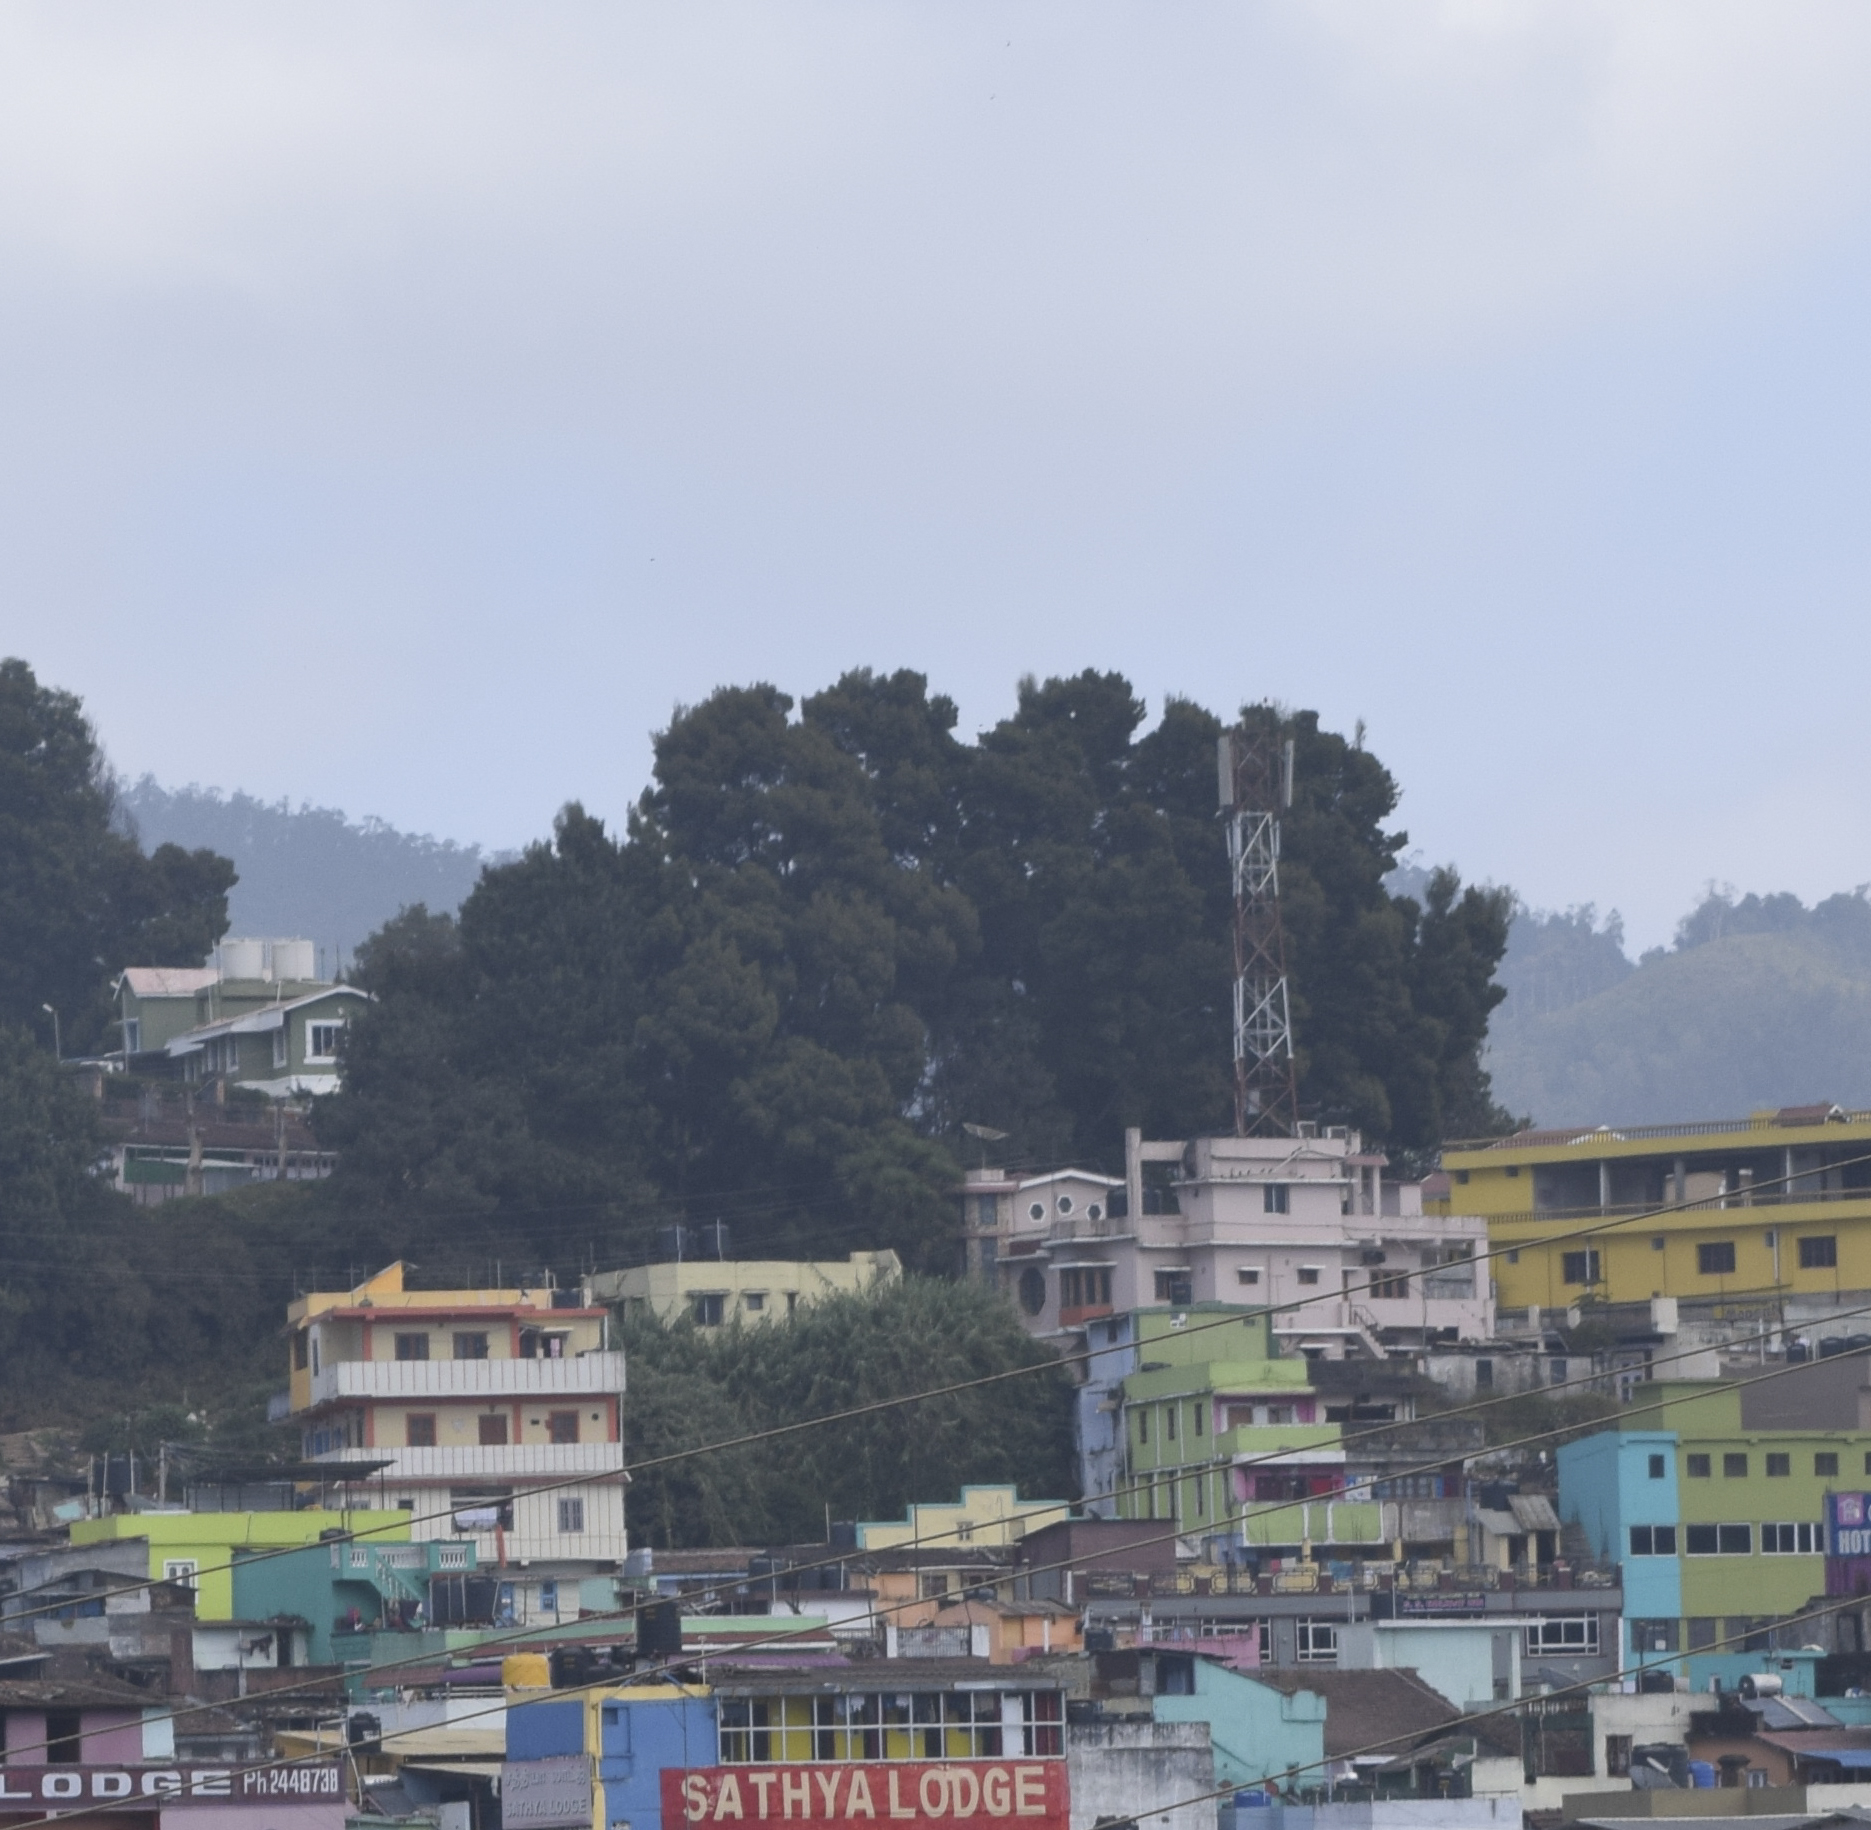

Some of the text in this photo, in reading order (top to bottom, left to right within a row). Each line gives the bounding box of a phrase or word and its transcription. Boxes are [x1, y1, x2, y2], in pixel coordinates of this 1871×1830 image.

[506, 1799, 587, 1817] SATHYA LODGE
[680, 1766, 1047, 1822] SATHYA LODGE
